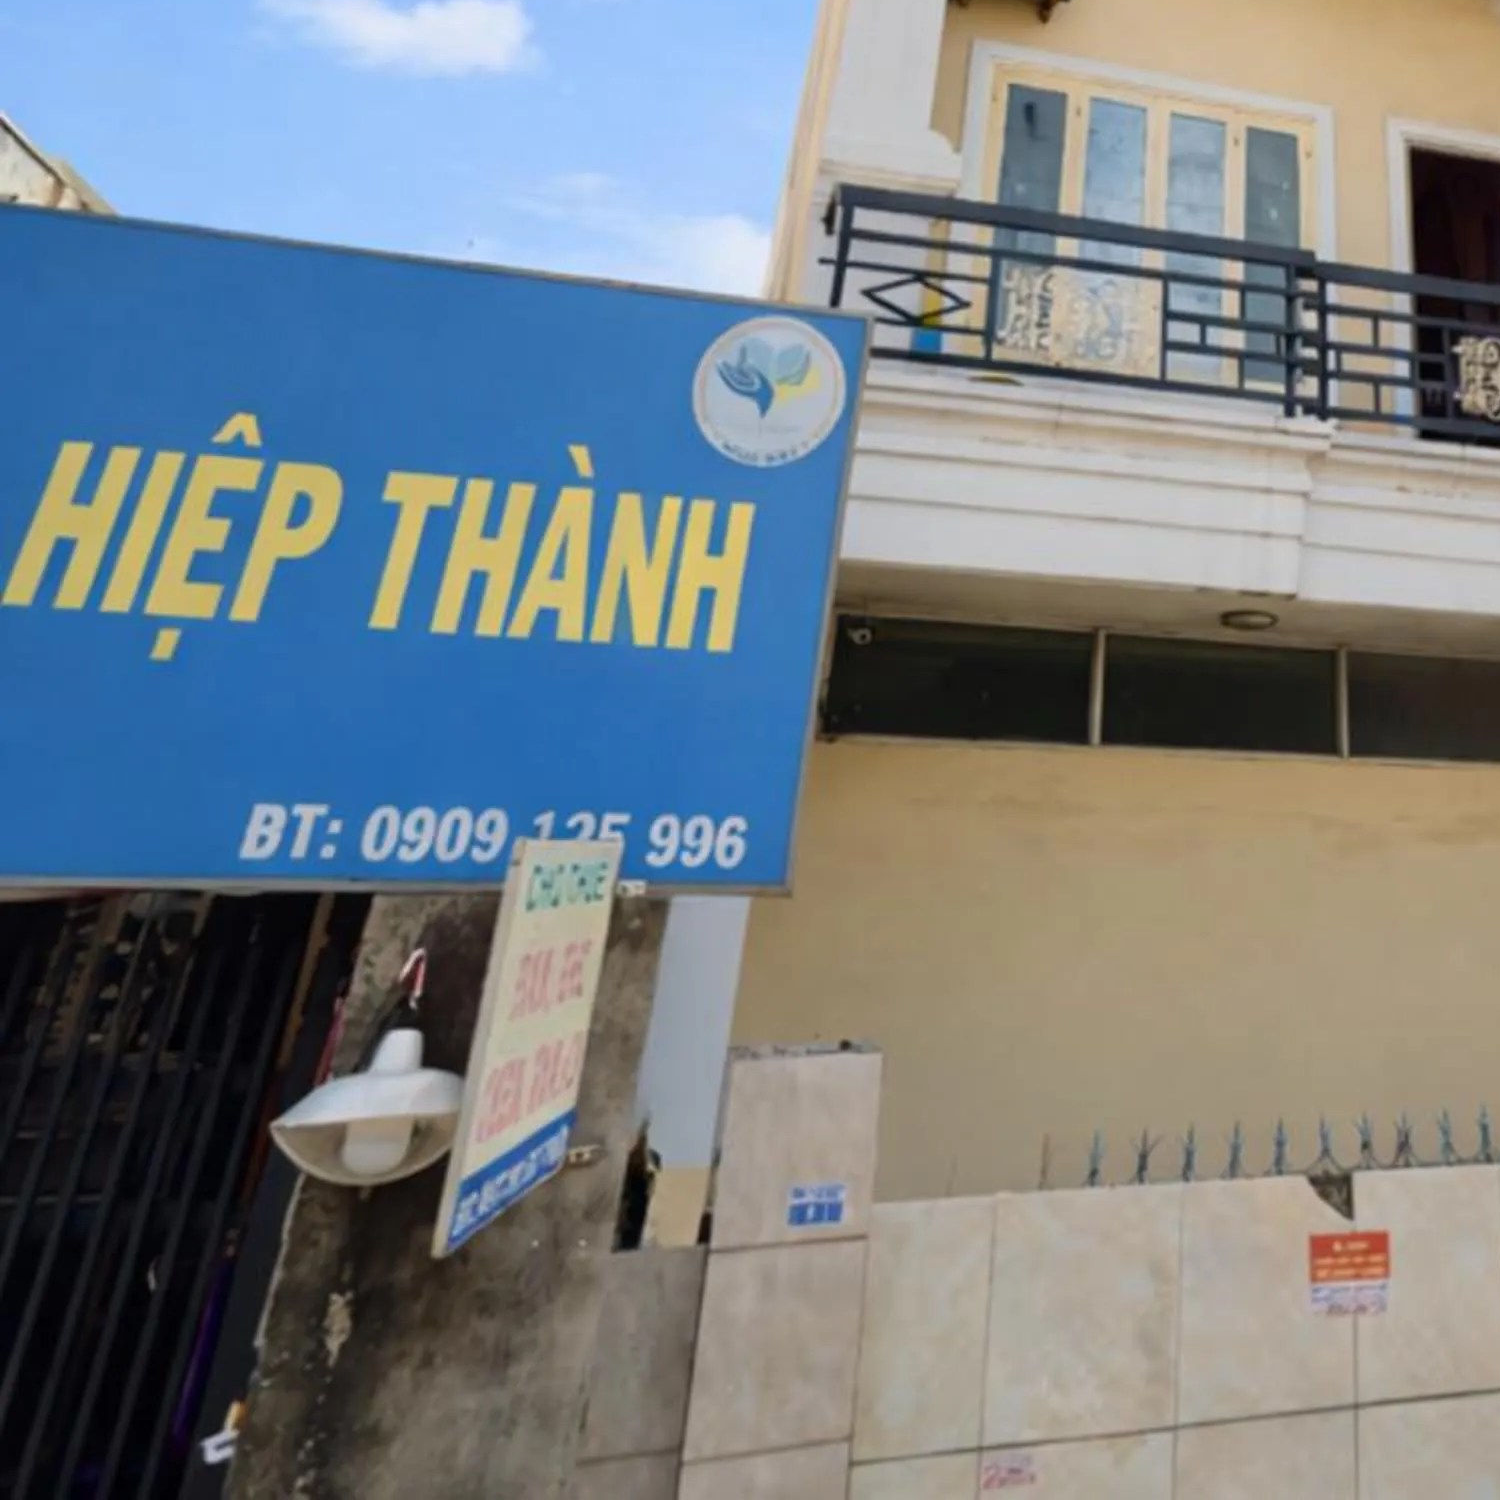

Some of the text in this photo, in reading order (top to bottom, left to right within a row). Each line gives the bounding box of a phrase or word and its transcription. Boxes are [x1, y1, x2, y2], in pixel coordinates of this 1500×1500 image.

[2, 412, 757, 661] HIỆP THÀNH
[239, 803, 343, 861] BT:
[360, 805, 510, 864] 0909
[645, 812, 749, 869] 996
